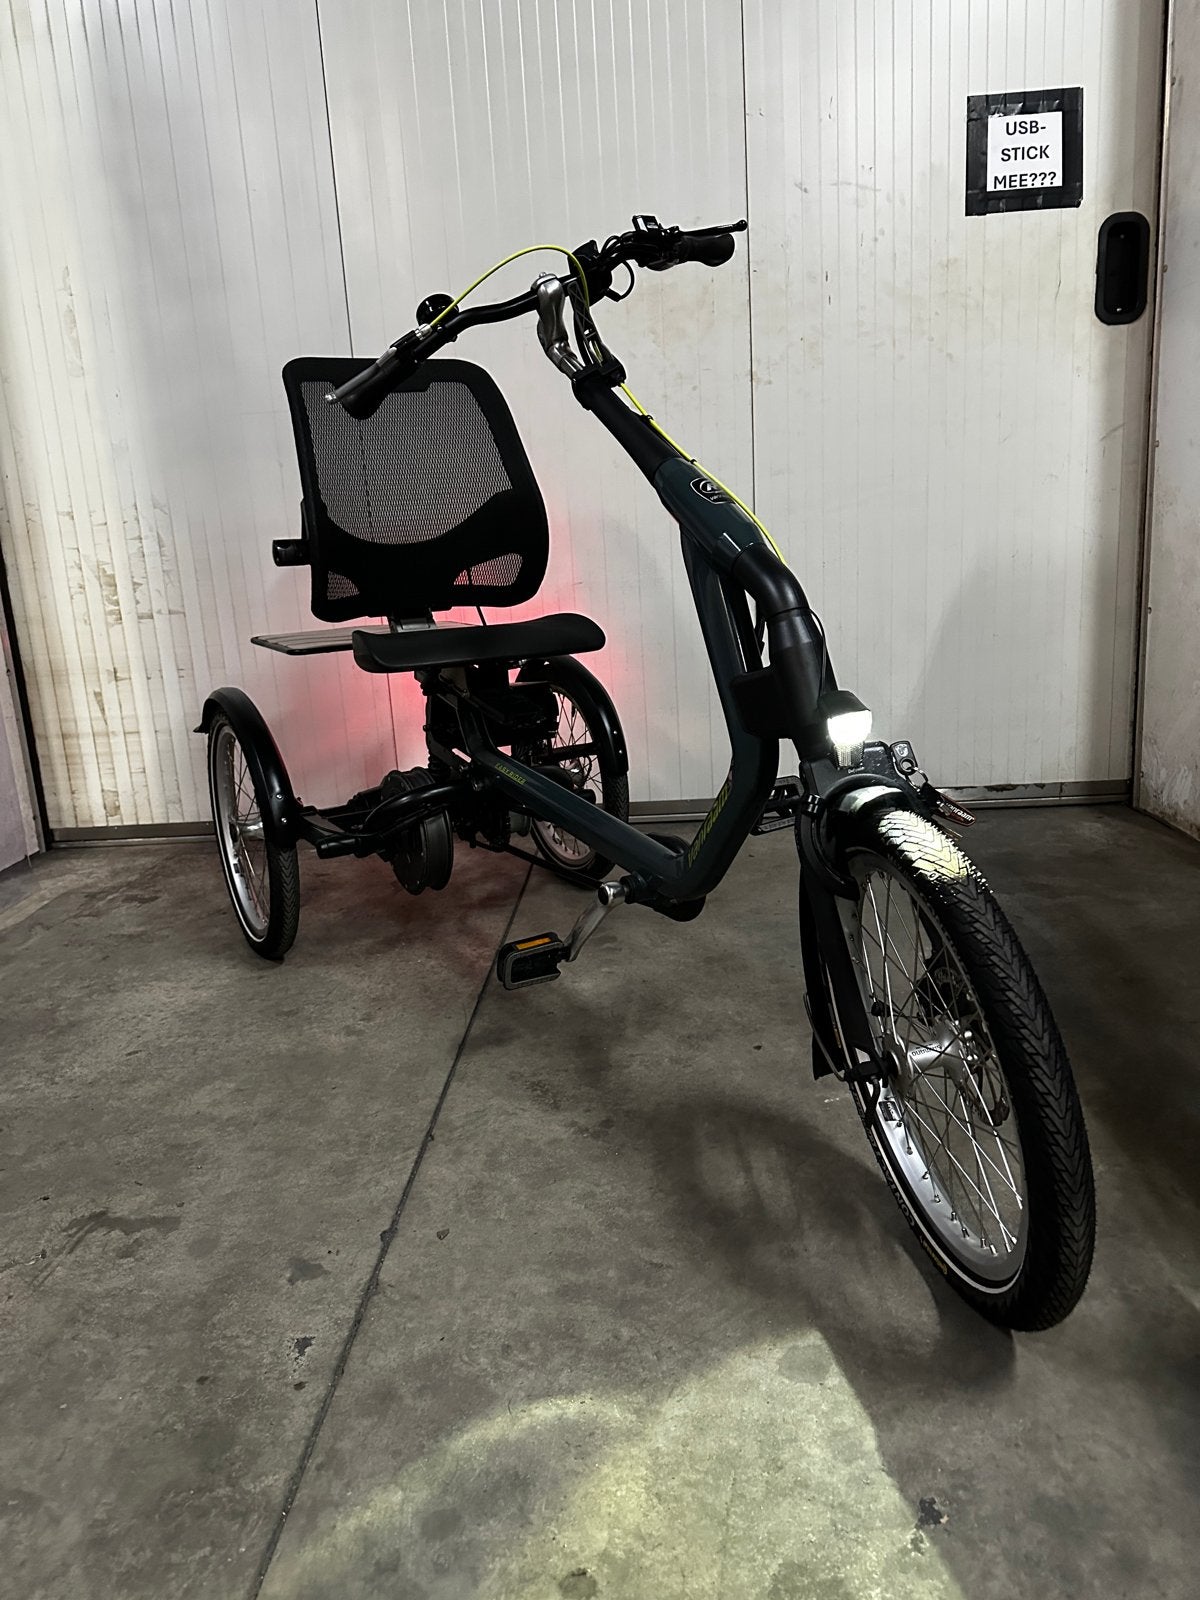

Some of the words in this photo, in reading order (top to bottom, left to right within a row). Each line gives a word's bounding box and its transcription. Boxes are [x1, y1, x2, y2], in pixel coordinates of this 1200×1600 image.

[1005, 120, 1047, 136] USB-
[1000, 144, 1050, 162] STICK
[993, 171, 1057, 190] MEE???
